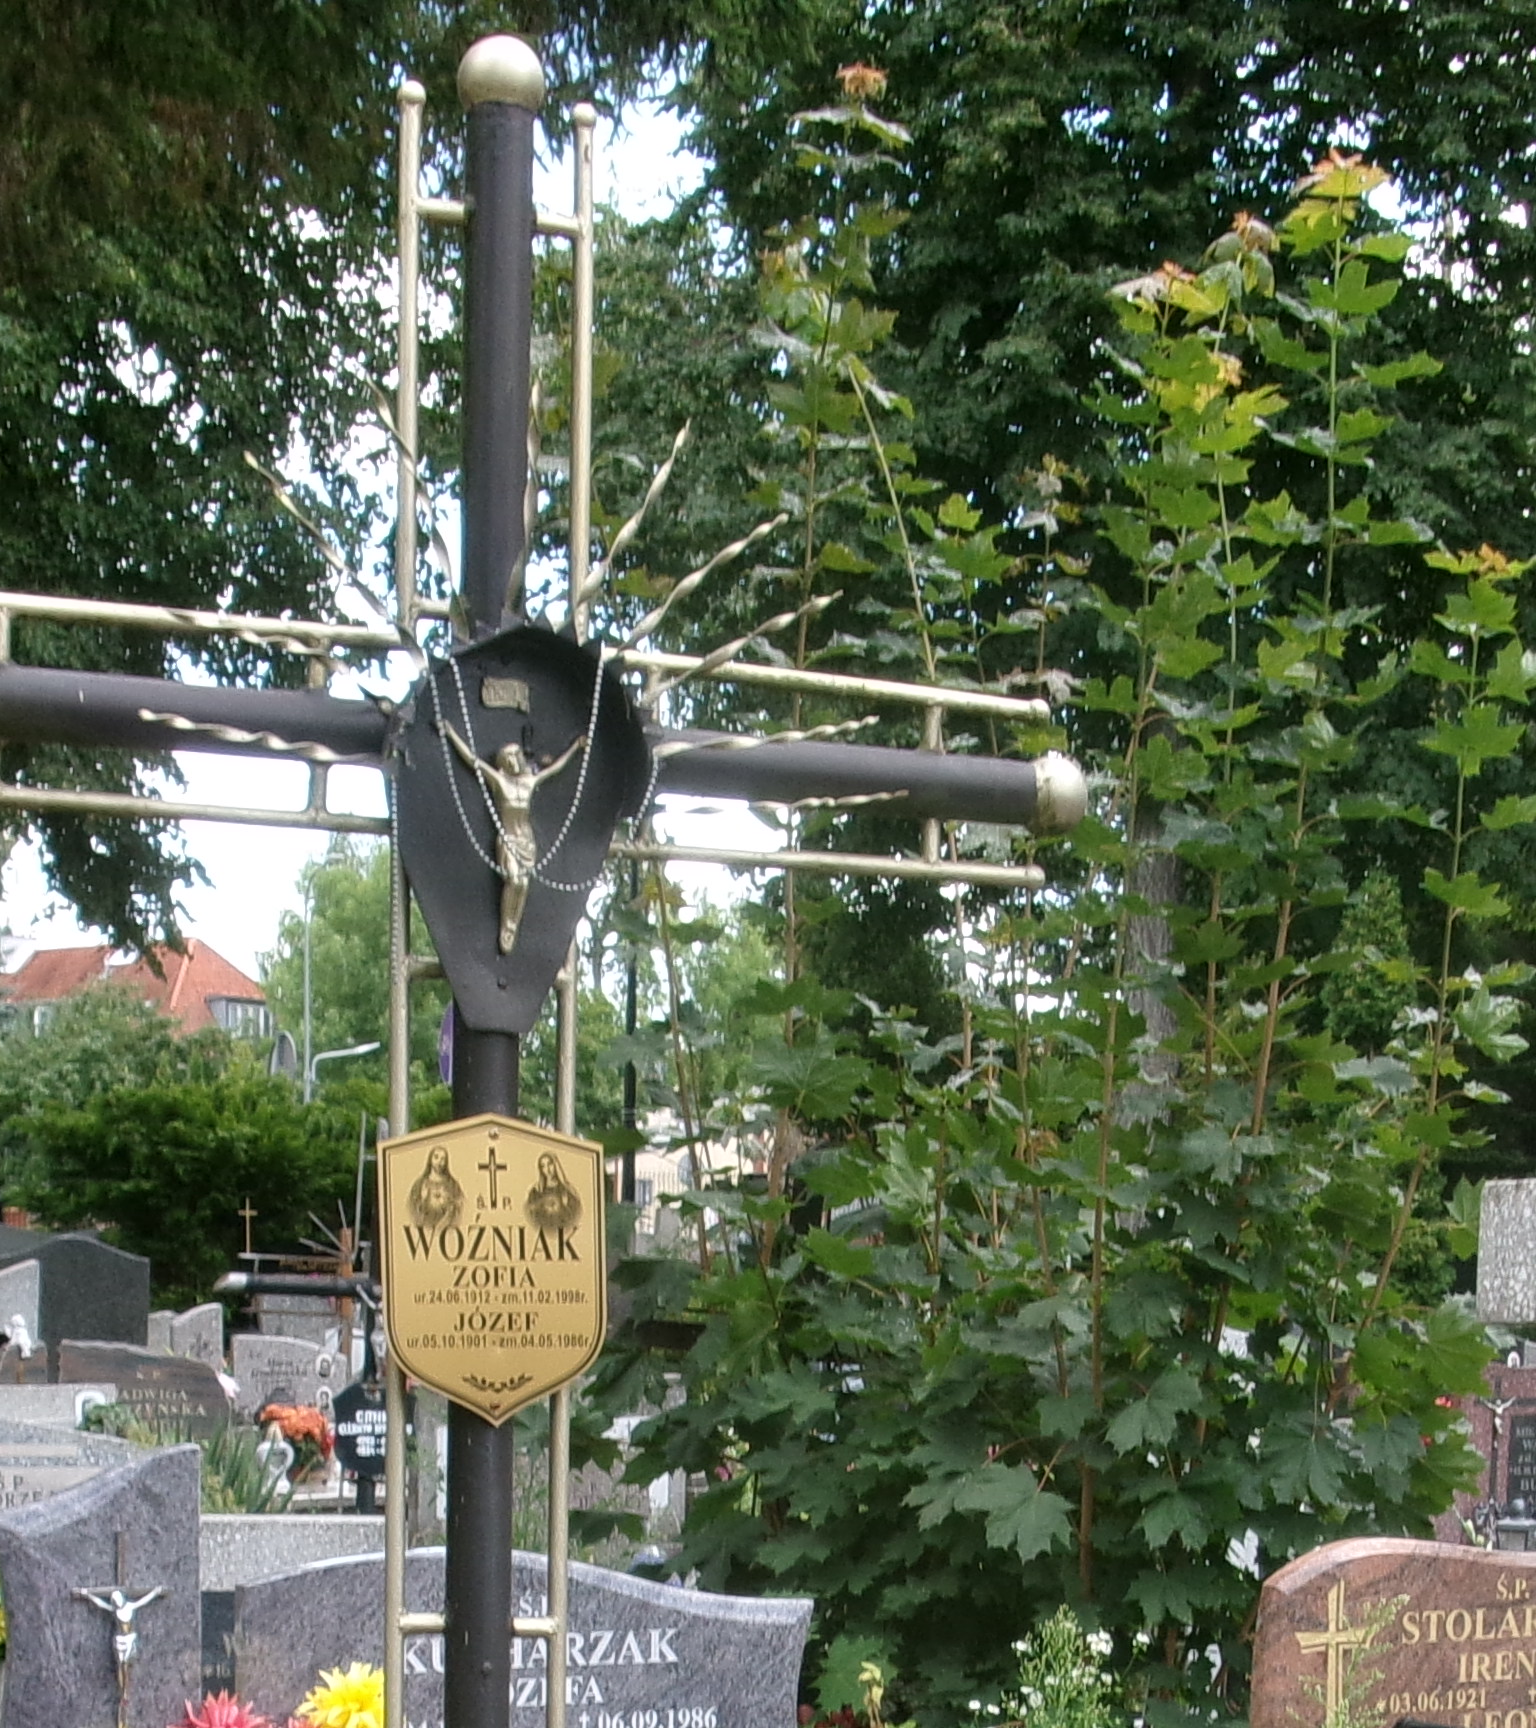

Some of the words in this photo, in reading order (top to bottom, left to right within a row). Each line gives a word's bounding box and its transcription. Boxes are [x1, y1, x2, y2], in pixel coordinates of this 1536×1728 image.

[403, 1213, 580, 1262] WOŹNIAK
[453, 1266, 535, 1288] ZOFIA
[454, 1305, 539, 1332] JÓZEF
[120, 1388, 188, 1401] ADWIGA
[1389, 1687, 1486, 1714] 03.06.1921
